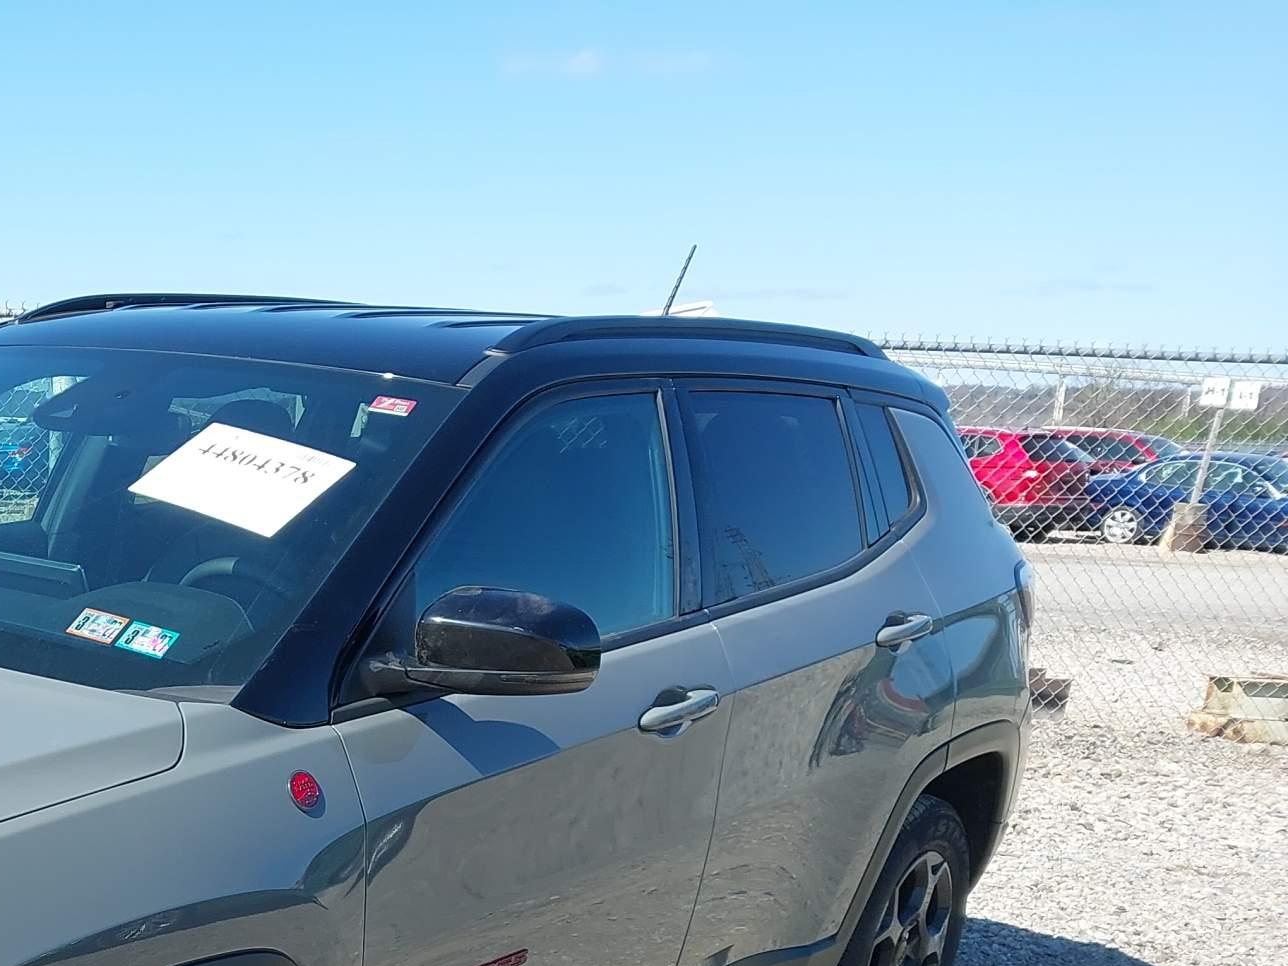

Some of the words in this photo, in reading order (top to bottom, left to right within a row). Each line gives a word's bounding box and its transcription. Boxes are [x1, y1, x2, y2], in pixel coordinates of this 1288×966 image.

[198, 443, 316, 484] 44804378
[75, 615, 90, 631] 3
[124, 629, 140, 645] 3
